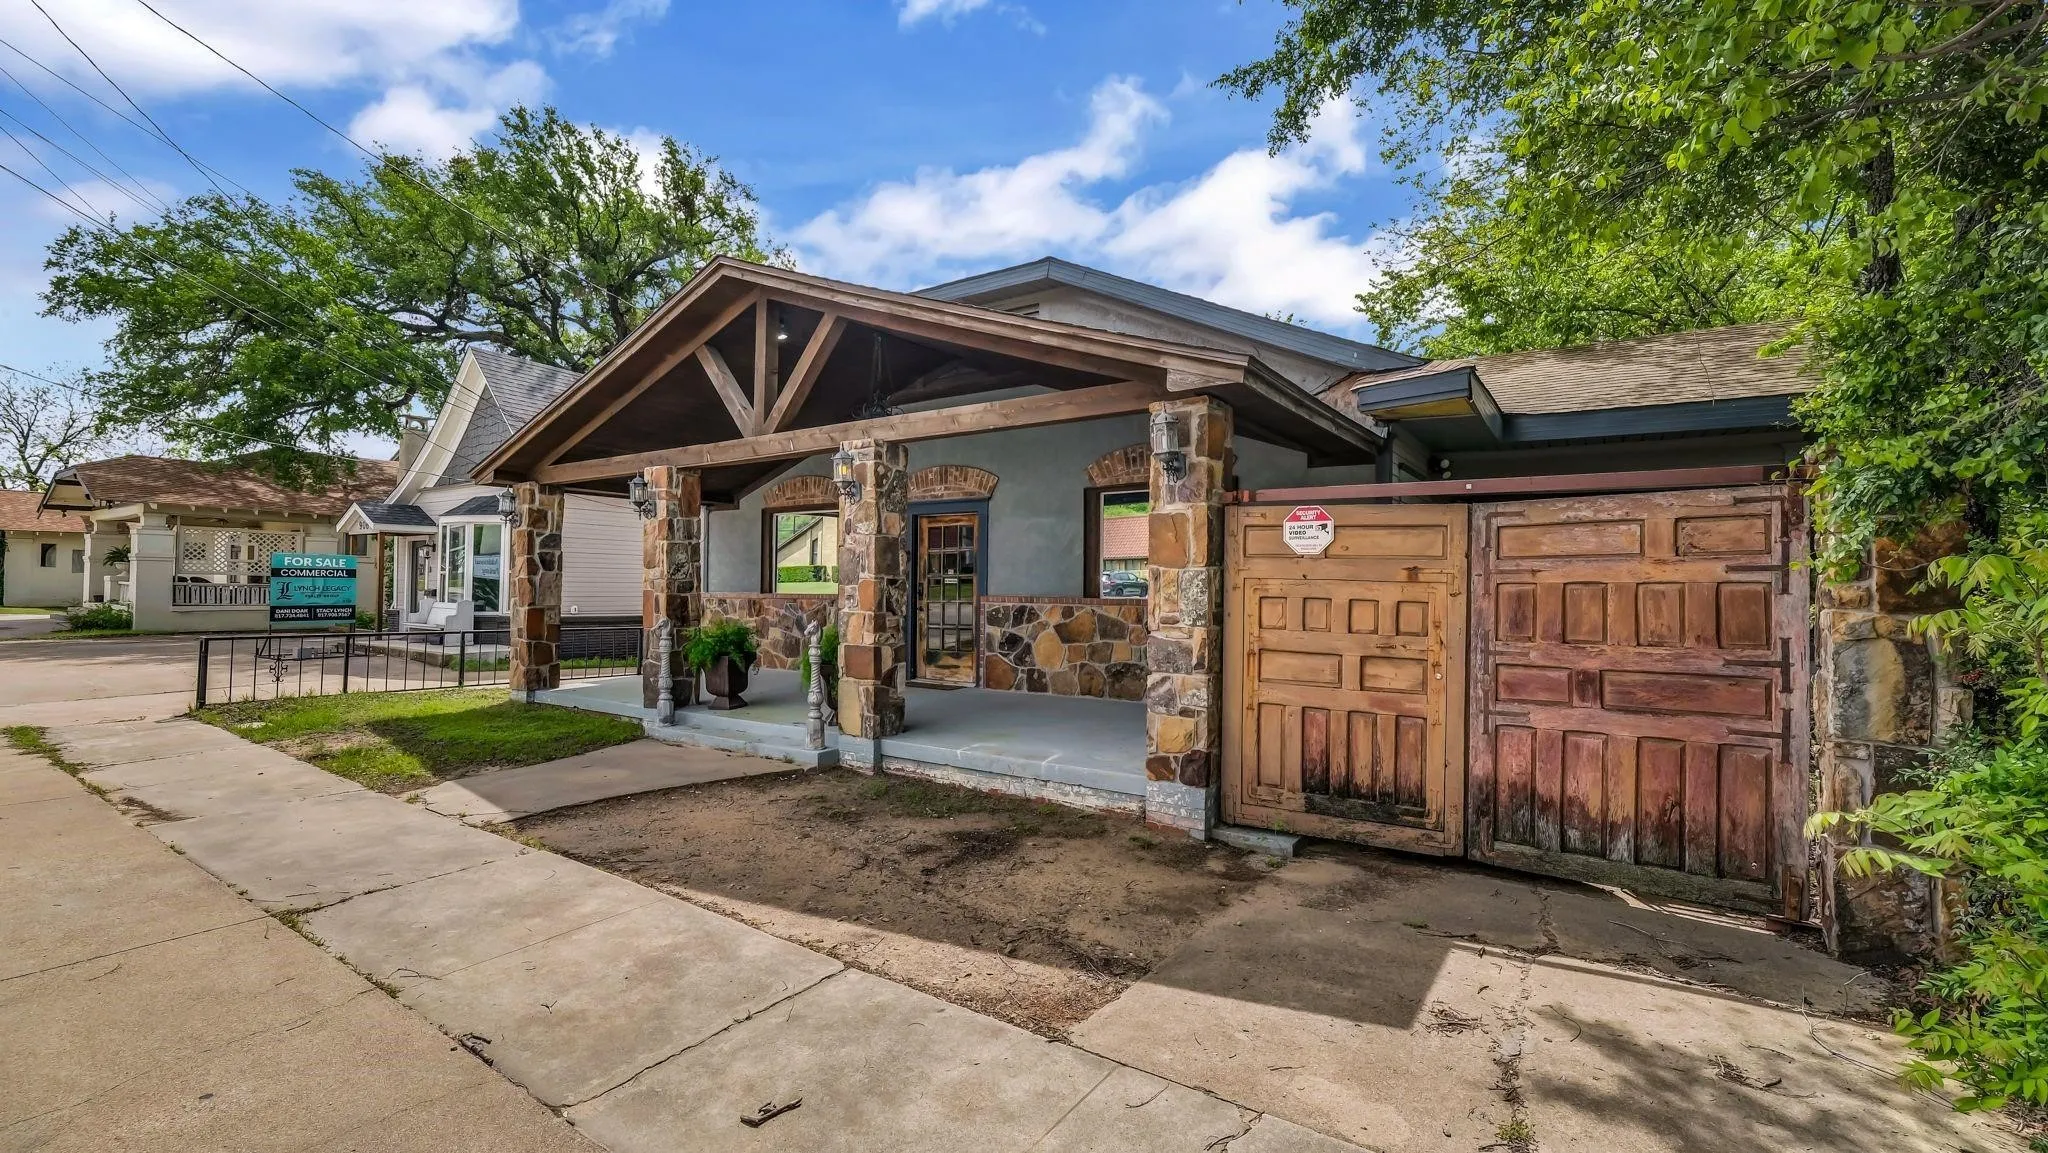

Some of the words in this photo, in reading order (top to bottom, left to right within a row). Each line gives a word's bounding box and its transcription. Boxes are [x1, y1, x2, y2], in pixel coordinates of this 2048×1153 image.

[284, 556, 312, 566] FOR
[315, 557, 347, 567] SALE
[280, 569, 348, 577] COMMERCIAL
